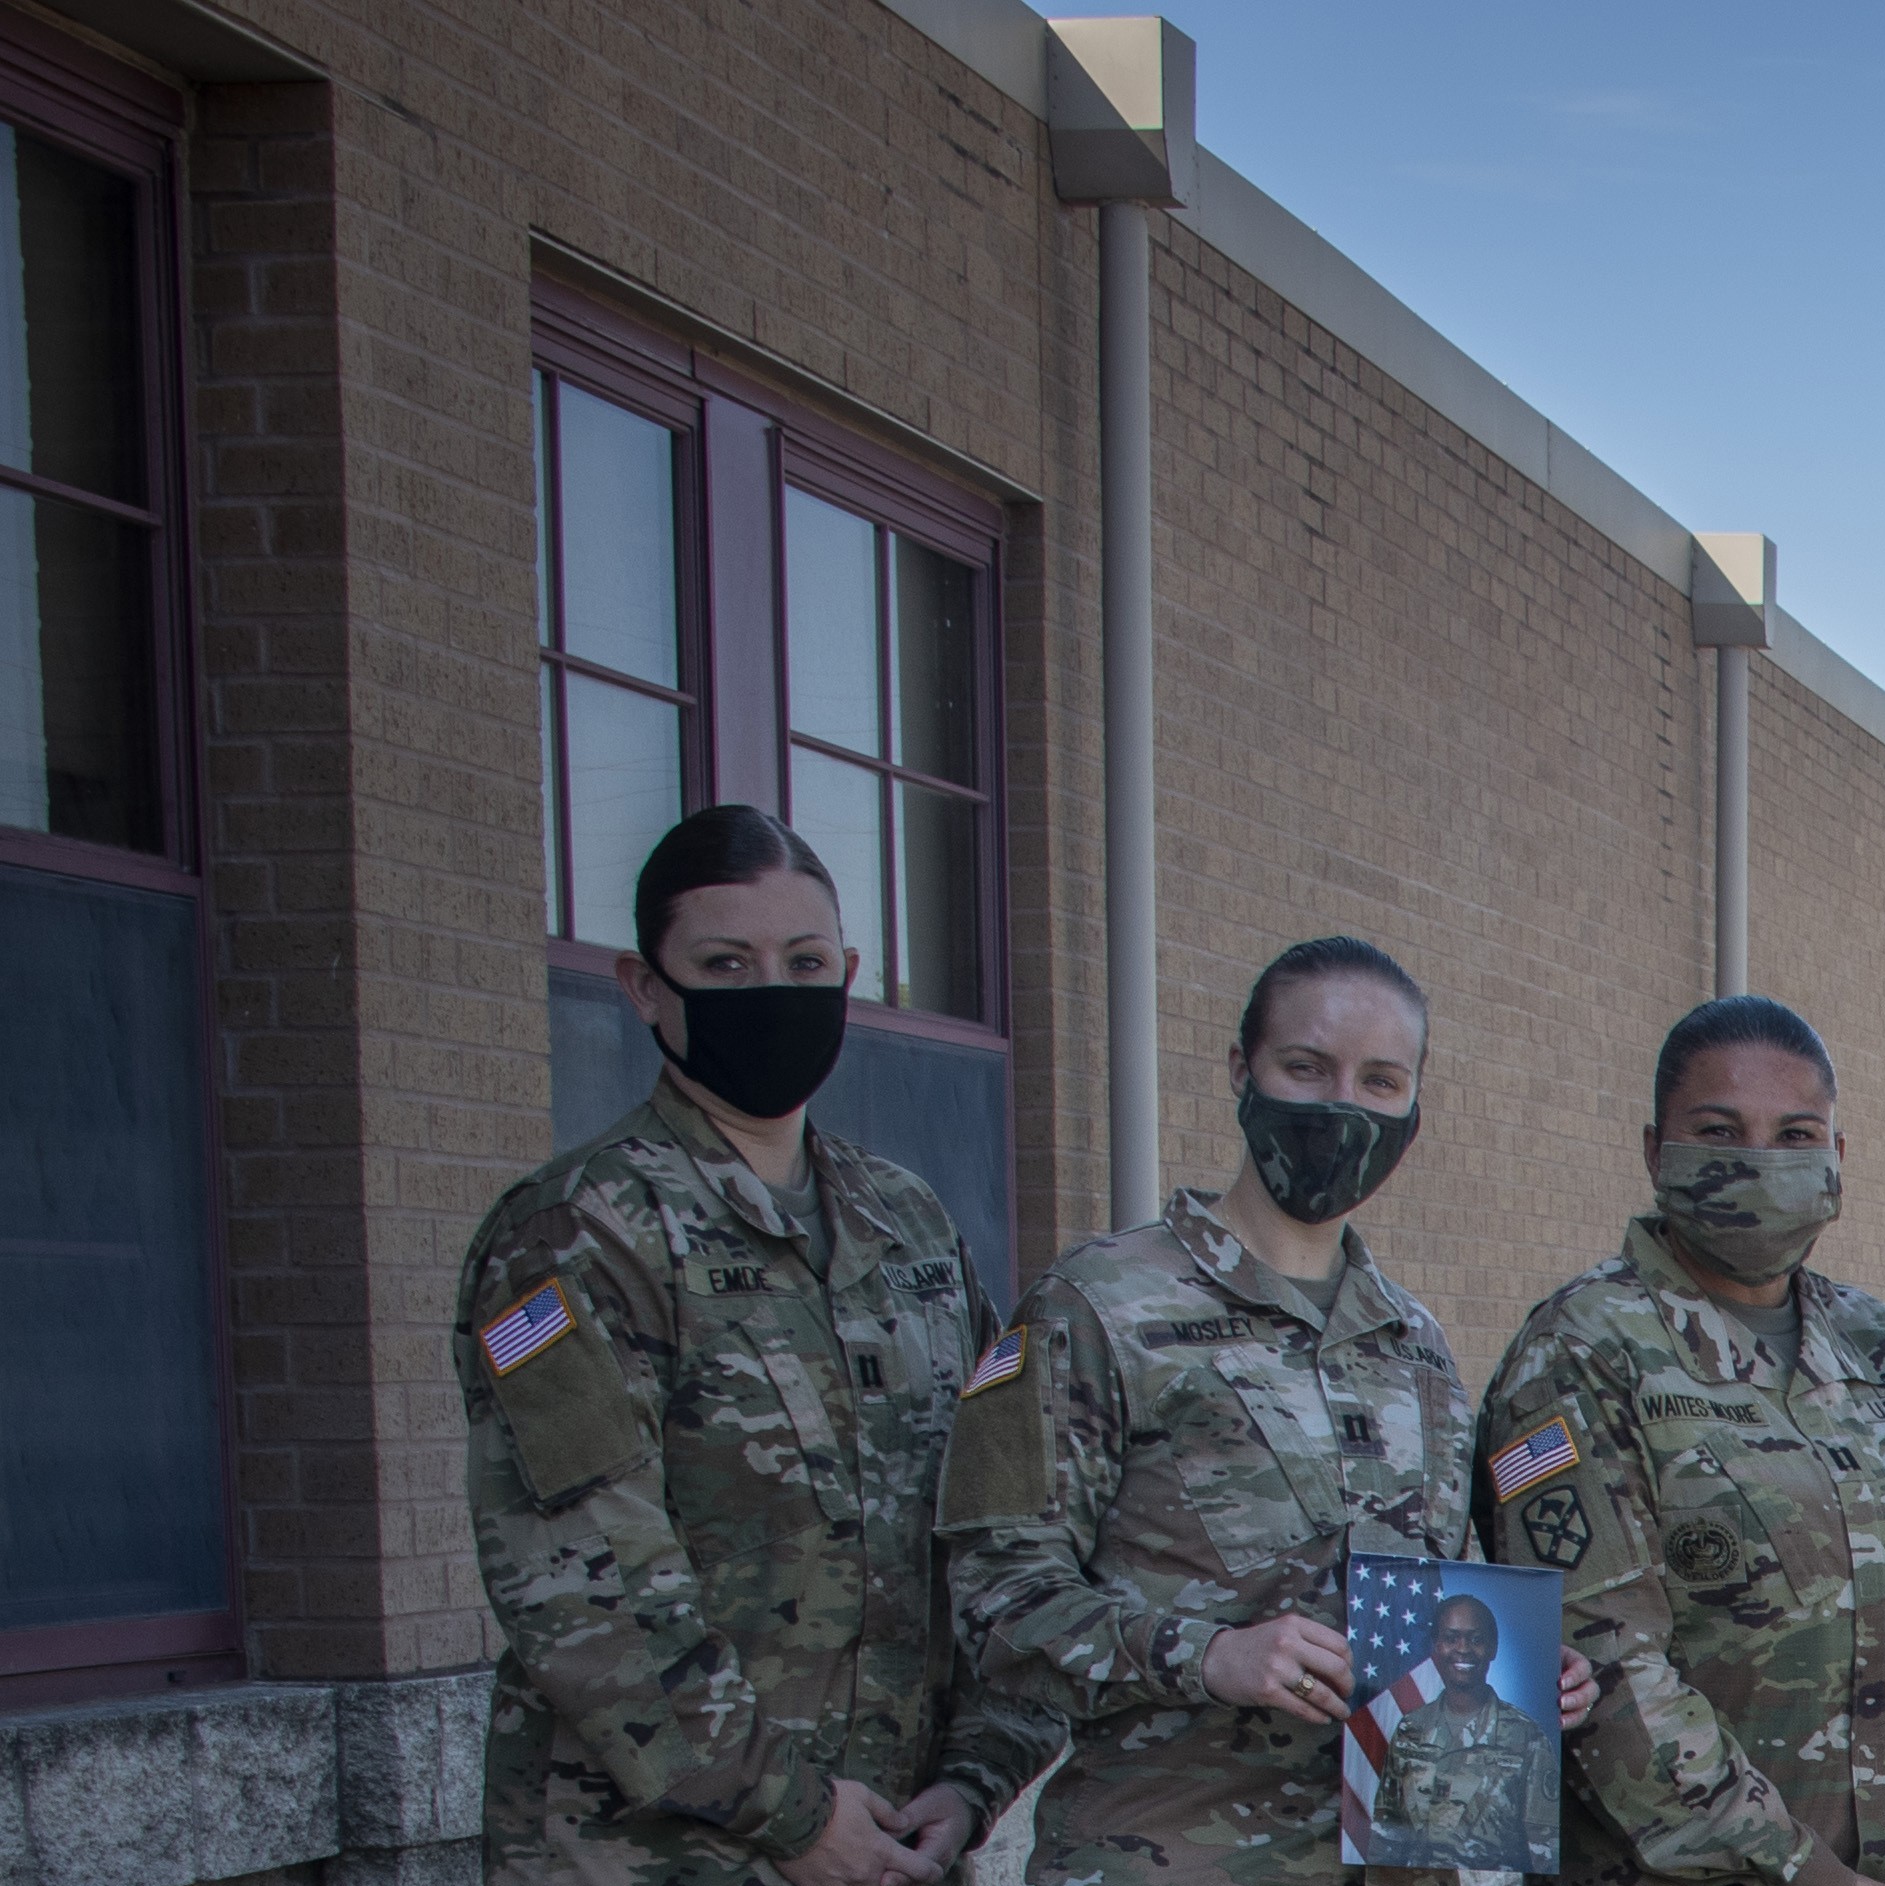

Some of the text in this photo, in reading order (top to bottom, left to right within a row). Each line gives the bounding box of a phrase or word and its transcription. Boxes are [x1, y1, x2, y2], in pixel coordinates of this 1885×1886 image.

[708, 1265, 774, 1294] EMDE
[1170, 1316, 1255, 1343] MOSLEY
[1641, 1393, 1758, 1425] WAITES-MOORE
